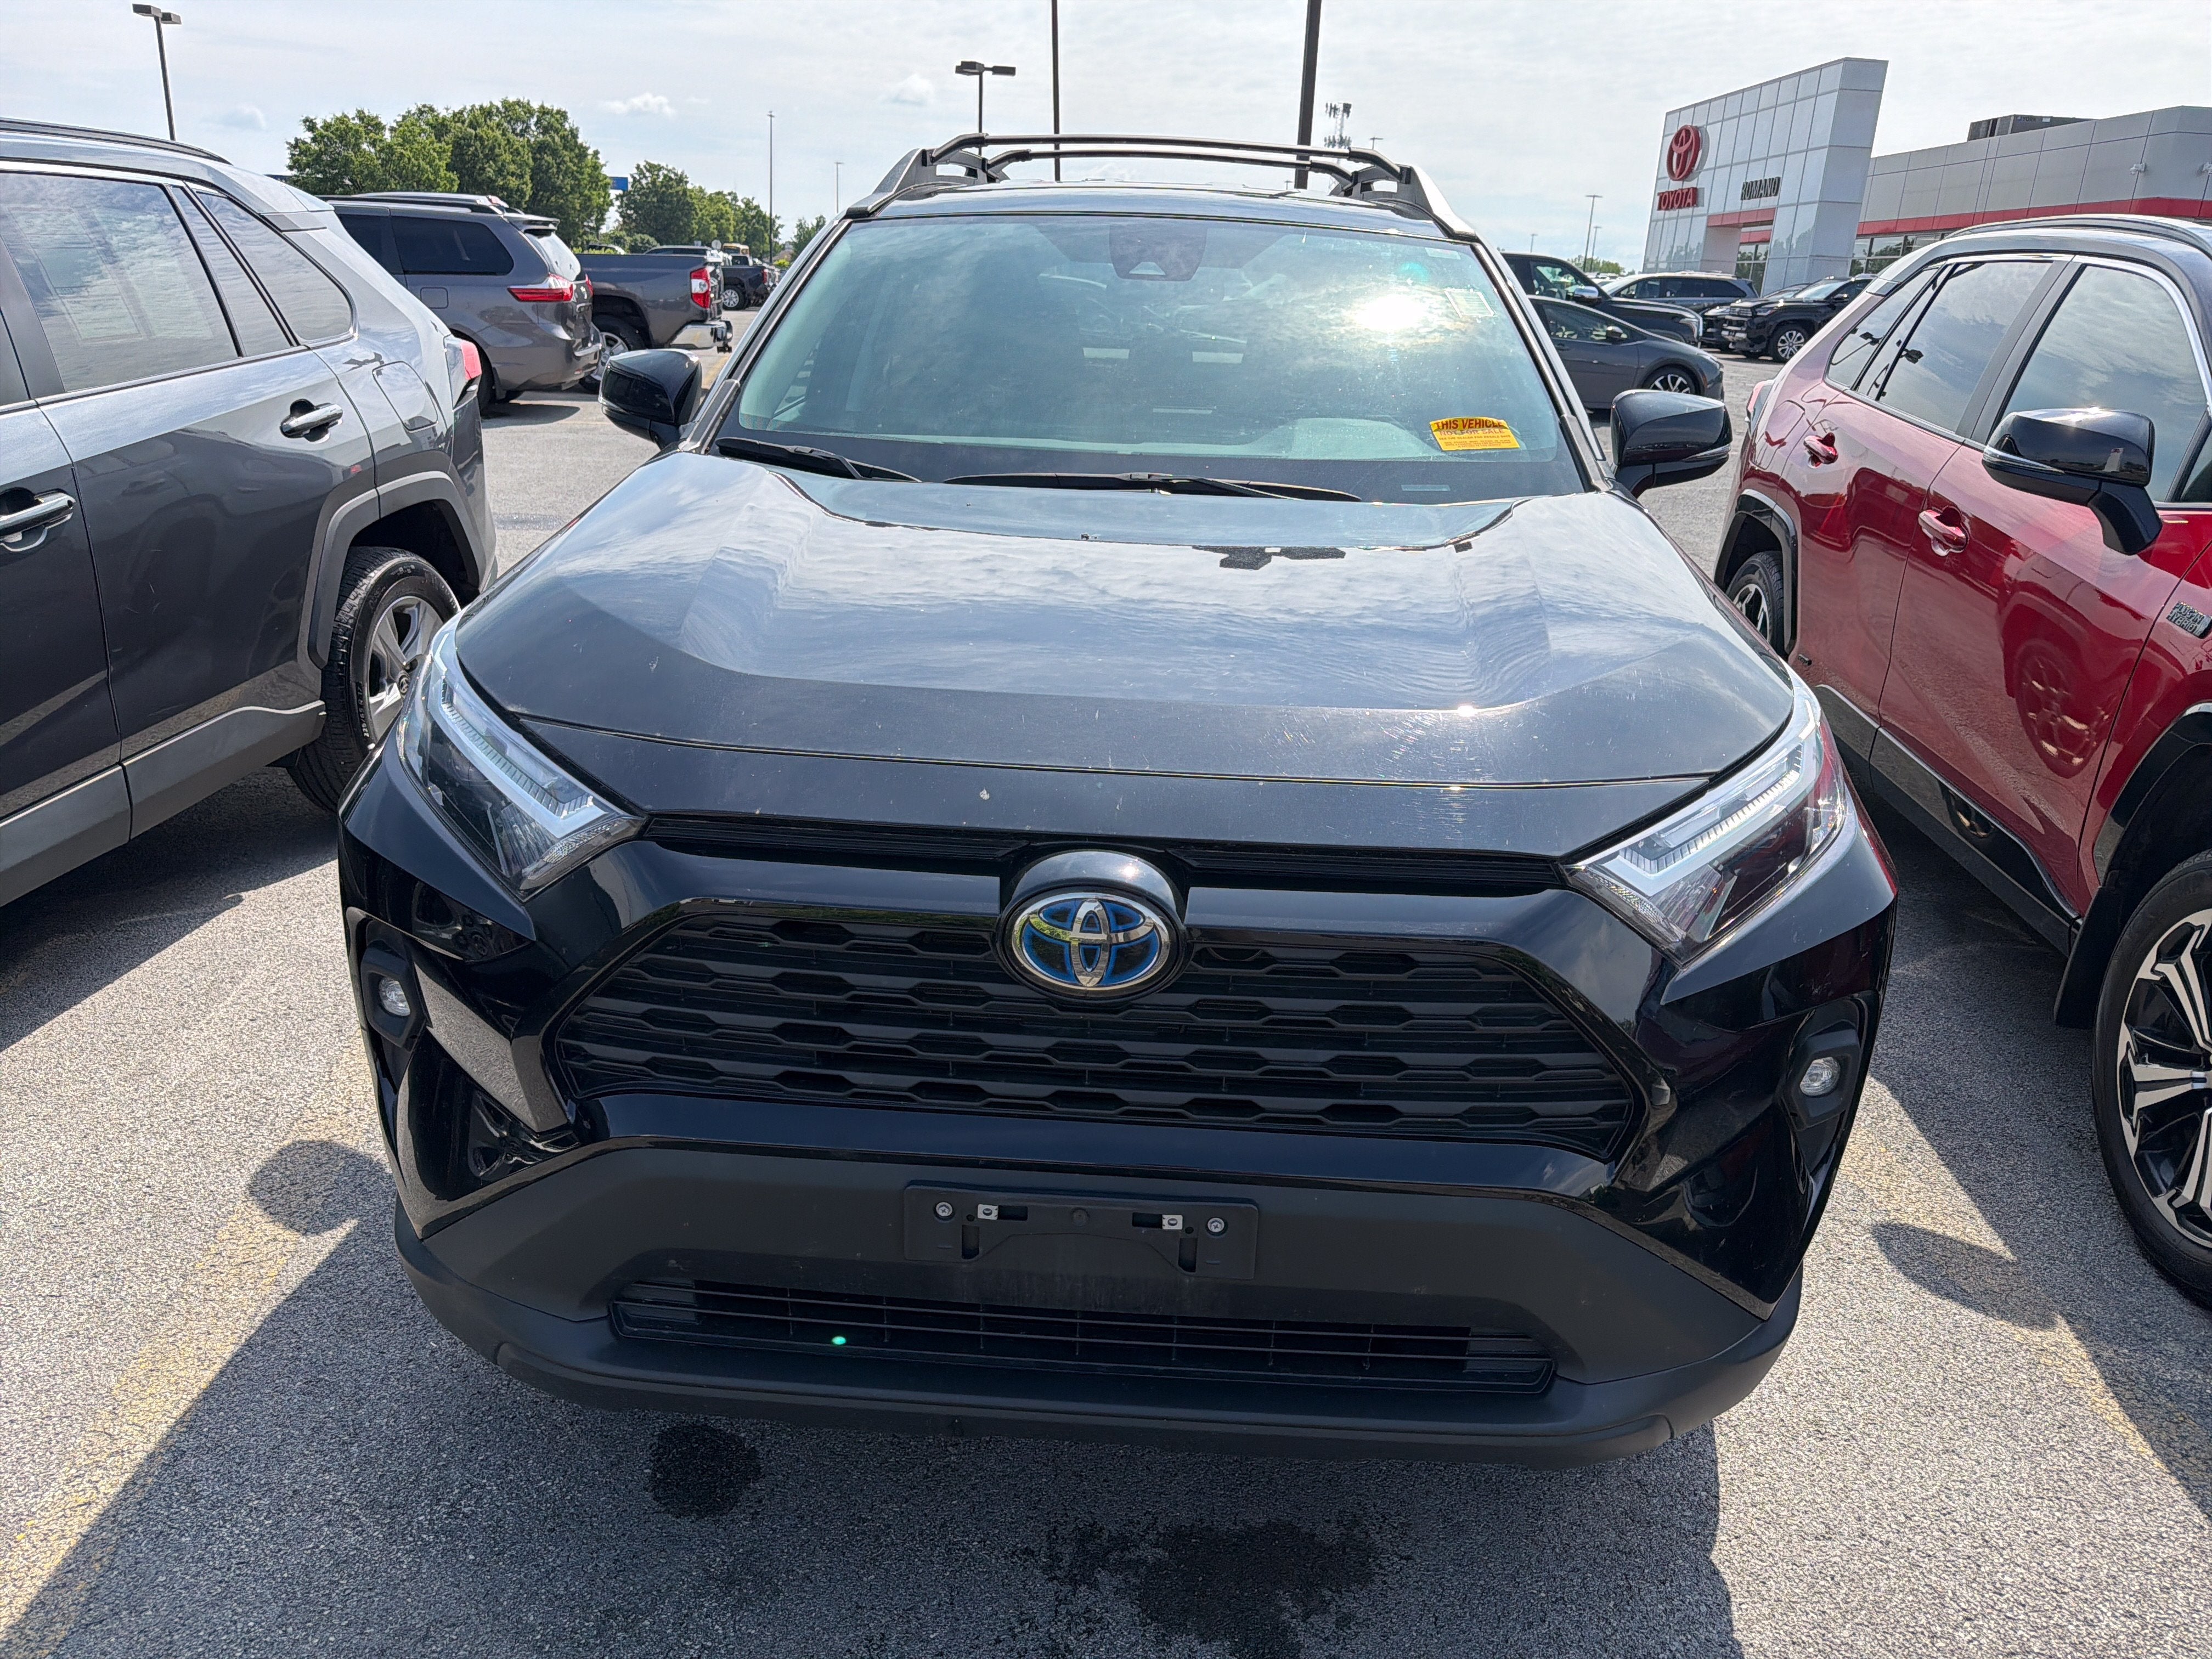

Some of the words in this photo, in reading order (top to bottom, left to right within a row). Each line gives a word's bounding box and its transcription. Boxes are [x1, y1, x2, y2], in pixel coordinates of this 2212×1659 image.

[1657, 187, 1698, 211] TOYOTA
[1740, 177, 1781, 201] ROMANO
[1434, 419, 1459, 430] THIS
[1462, 419, 1504, 430] VEHICLE
